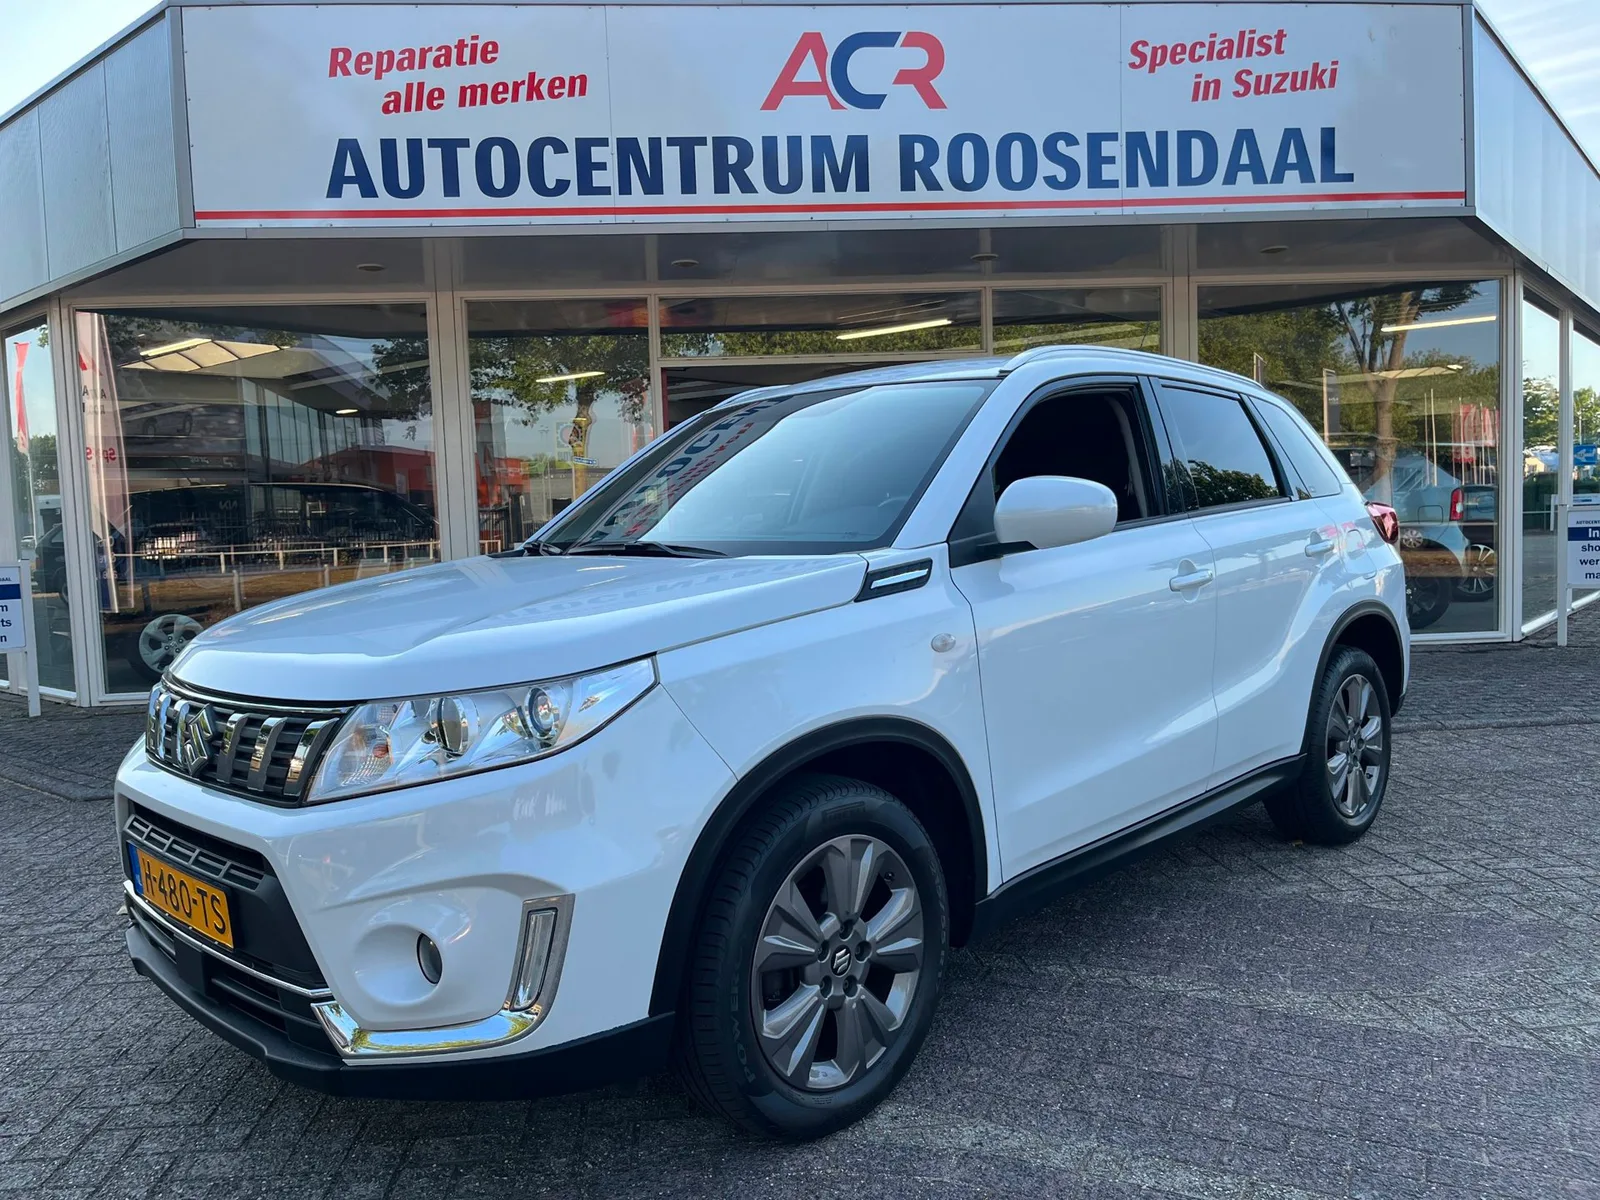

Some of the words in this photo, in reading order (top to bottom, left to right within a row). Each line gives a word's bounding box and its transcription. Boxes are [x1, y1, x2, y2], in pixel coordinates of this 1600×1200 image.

[328, 34, 500, 80] Reparatie
[759, 31, 947, 111] ACR
[1128, 28, 1287, 74] Specialist
[381, 81, 446, 115] alle
[458, 72, 588, 108] merken
[1191, 73, 1221, 103] in
[1232, 60, 1339, 98] Suzuki
[326, 134, 870, 200] AUTOCENTRUM
[899, 126, 1355, 193] ROOSENDAAL
[142, 857, 227, 935] H-480-TS
